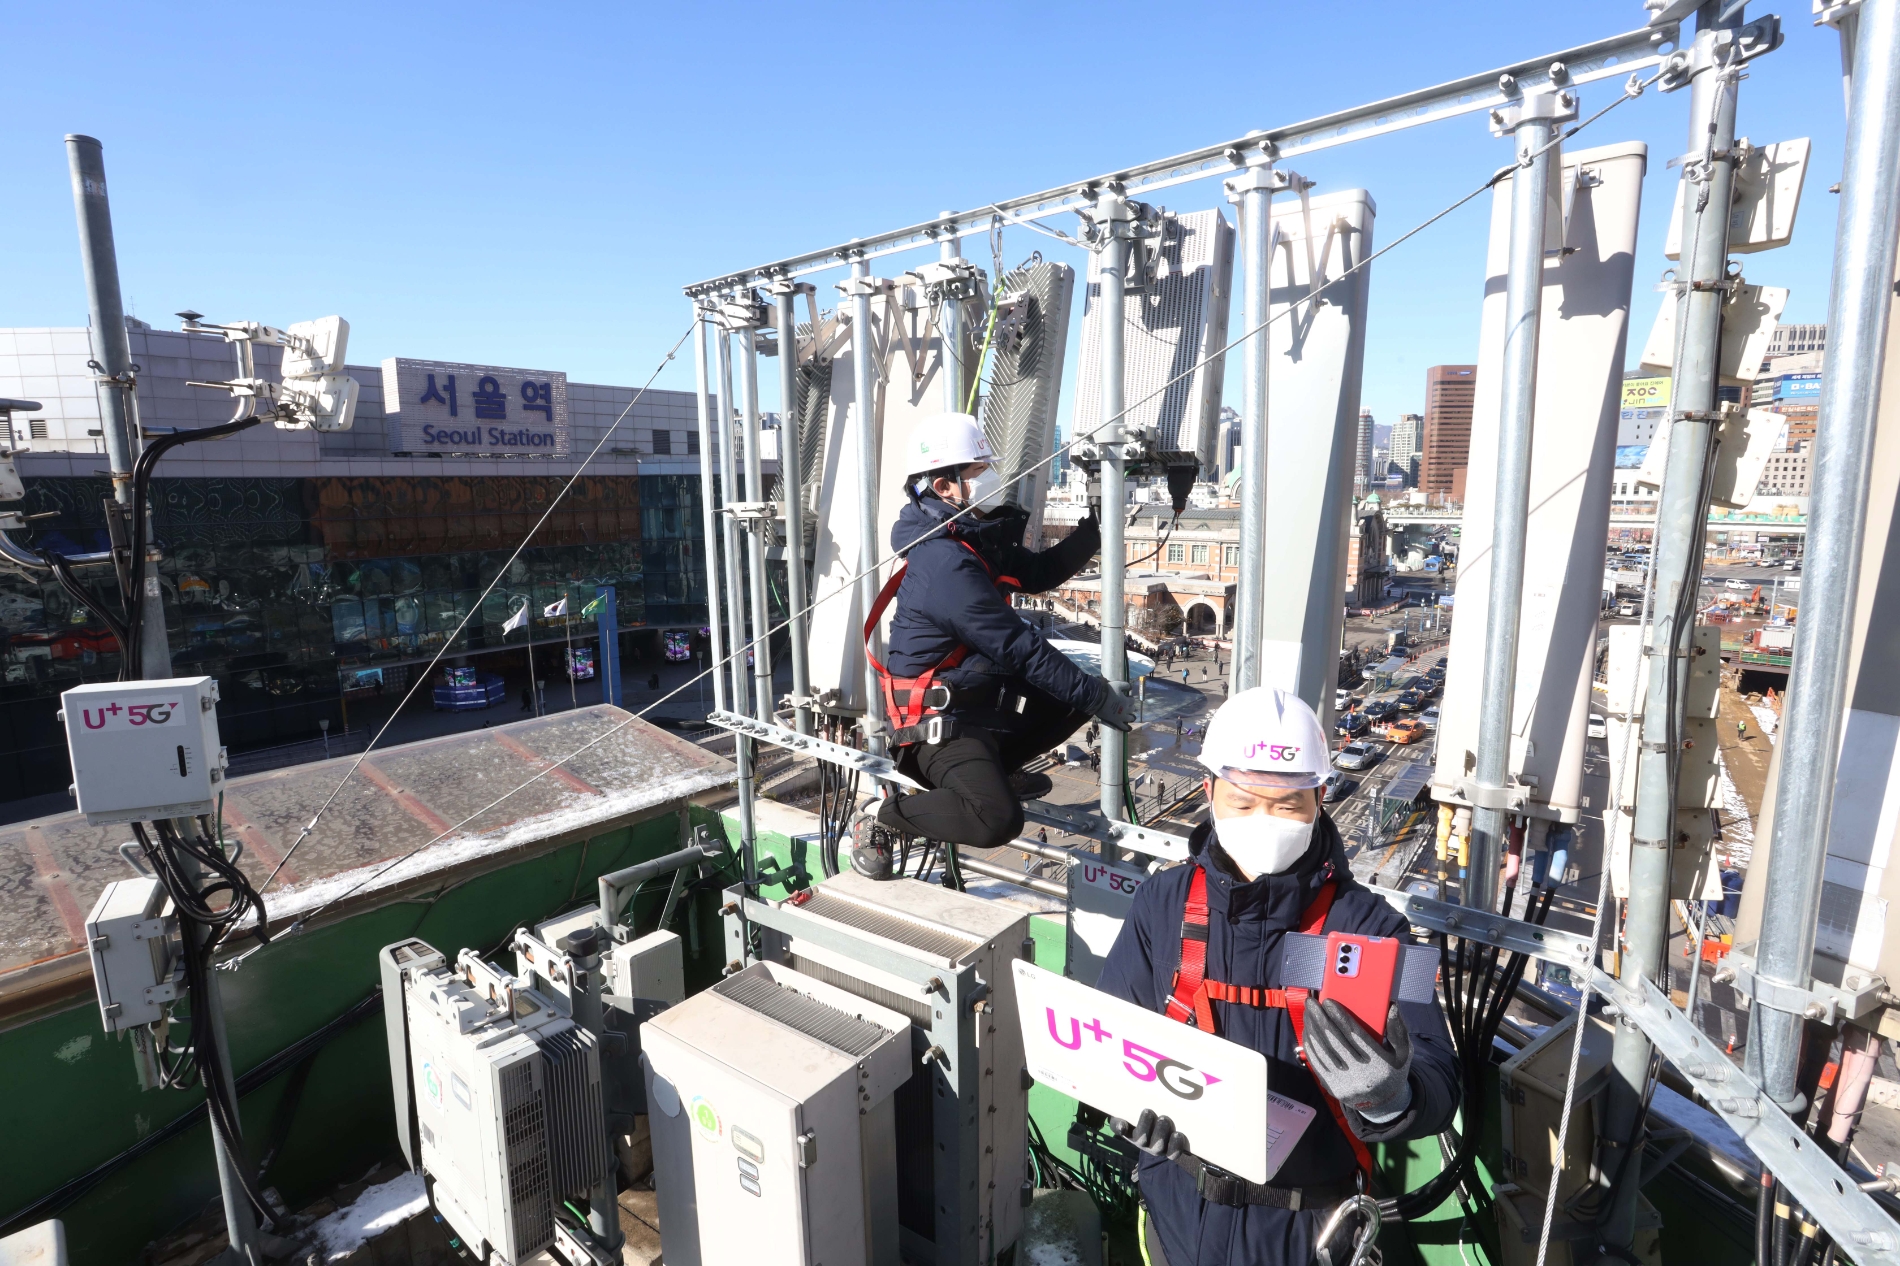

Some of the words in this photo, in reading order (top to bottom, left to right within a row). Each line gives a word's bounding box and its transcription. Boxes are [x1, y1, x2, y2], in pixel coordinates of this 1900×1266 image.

[420, 374, 553, 422] 서울역
[423, 424, 482, 445] Seoul
[488, 427, 555, 447] Station
[83, 702, 123, 730] U+
[128, 703, 172, 726] 5G
[1244, 741, 1267, 758] U+
[1270, 745, 1296, 761] 5G
[1085, 865, 1107, 883] U+
[1109, 872, 1136, 894] 5G
[1045, 1006, 1113, 1051] U+
[1122, 1038, 1205, 1101] 5G
